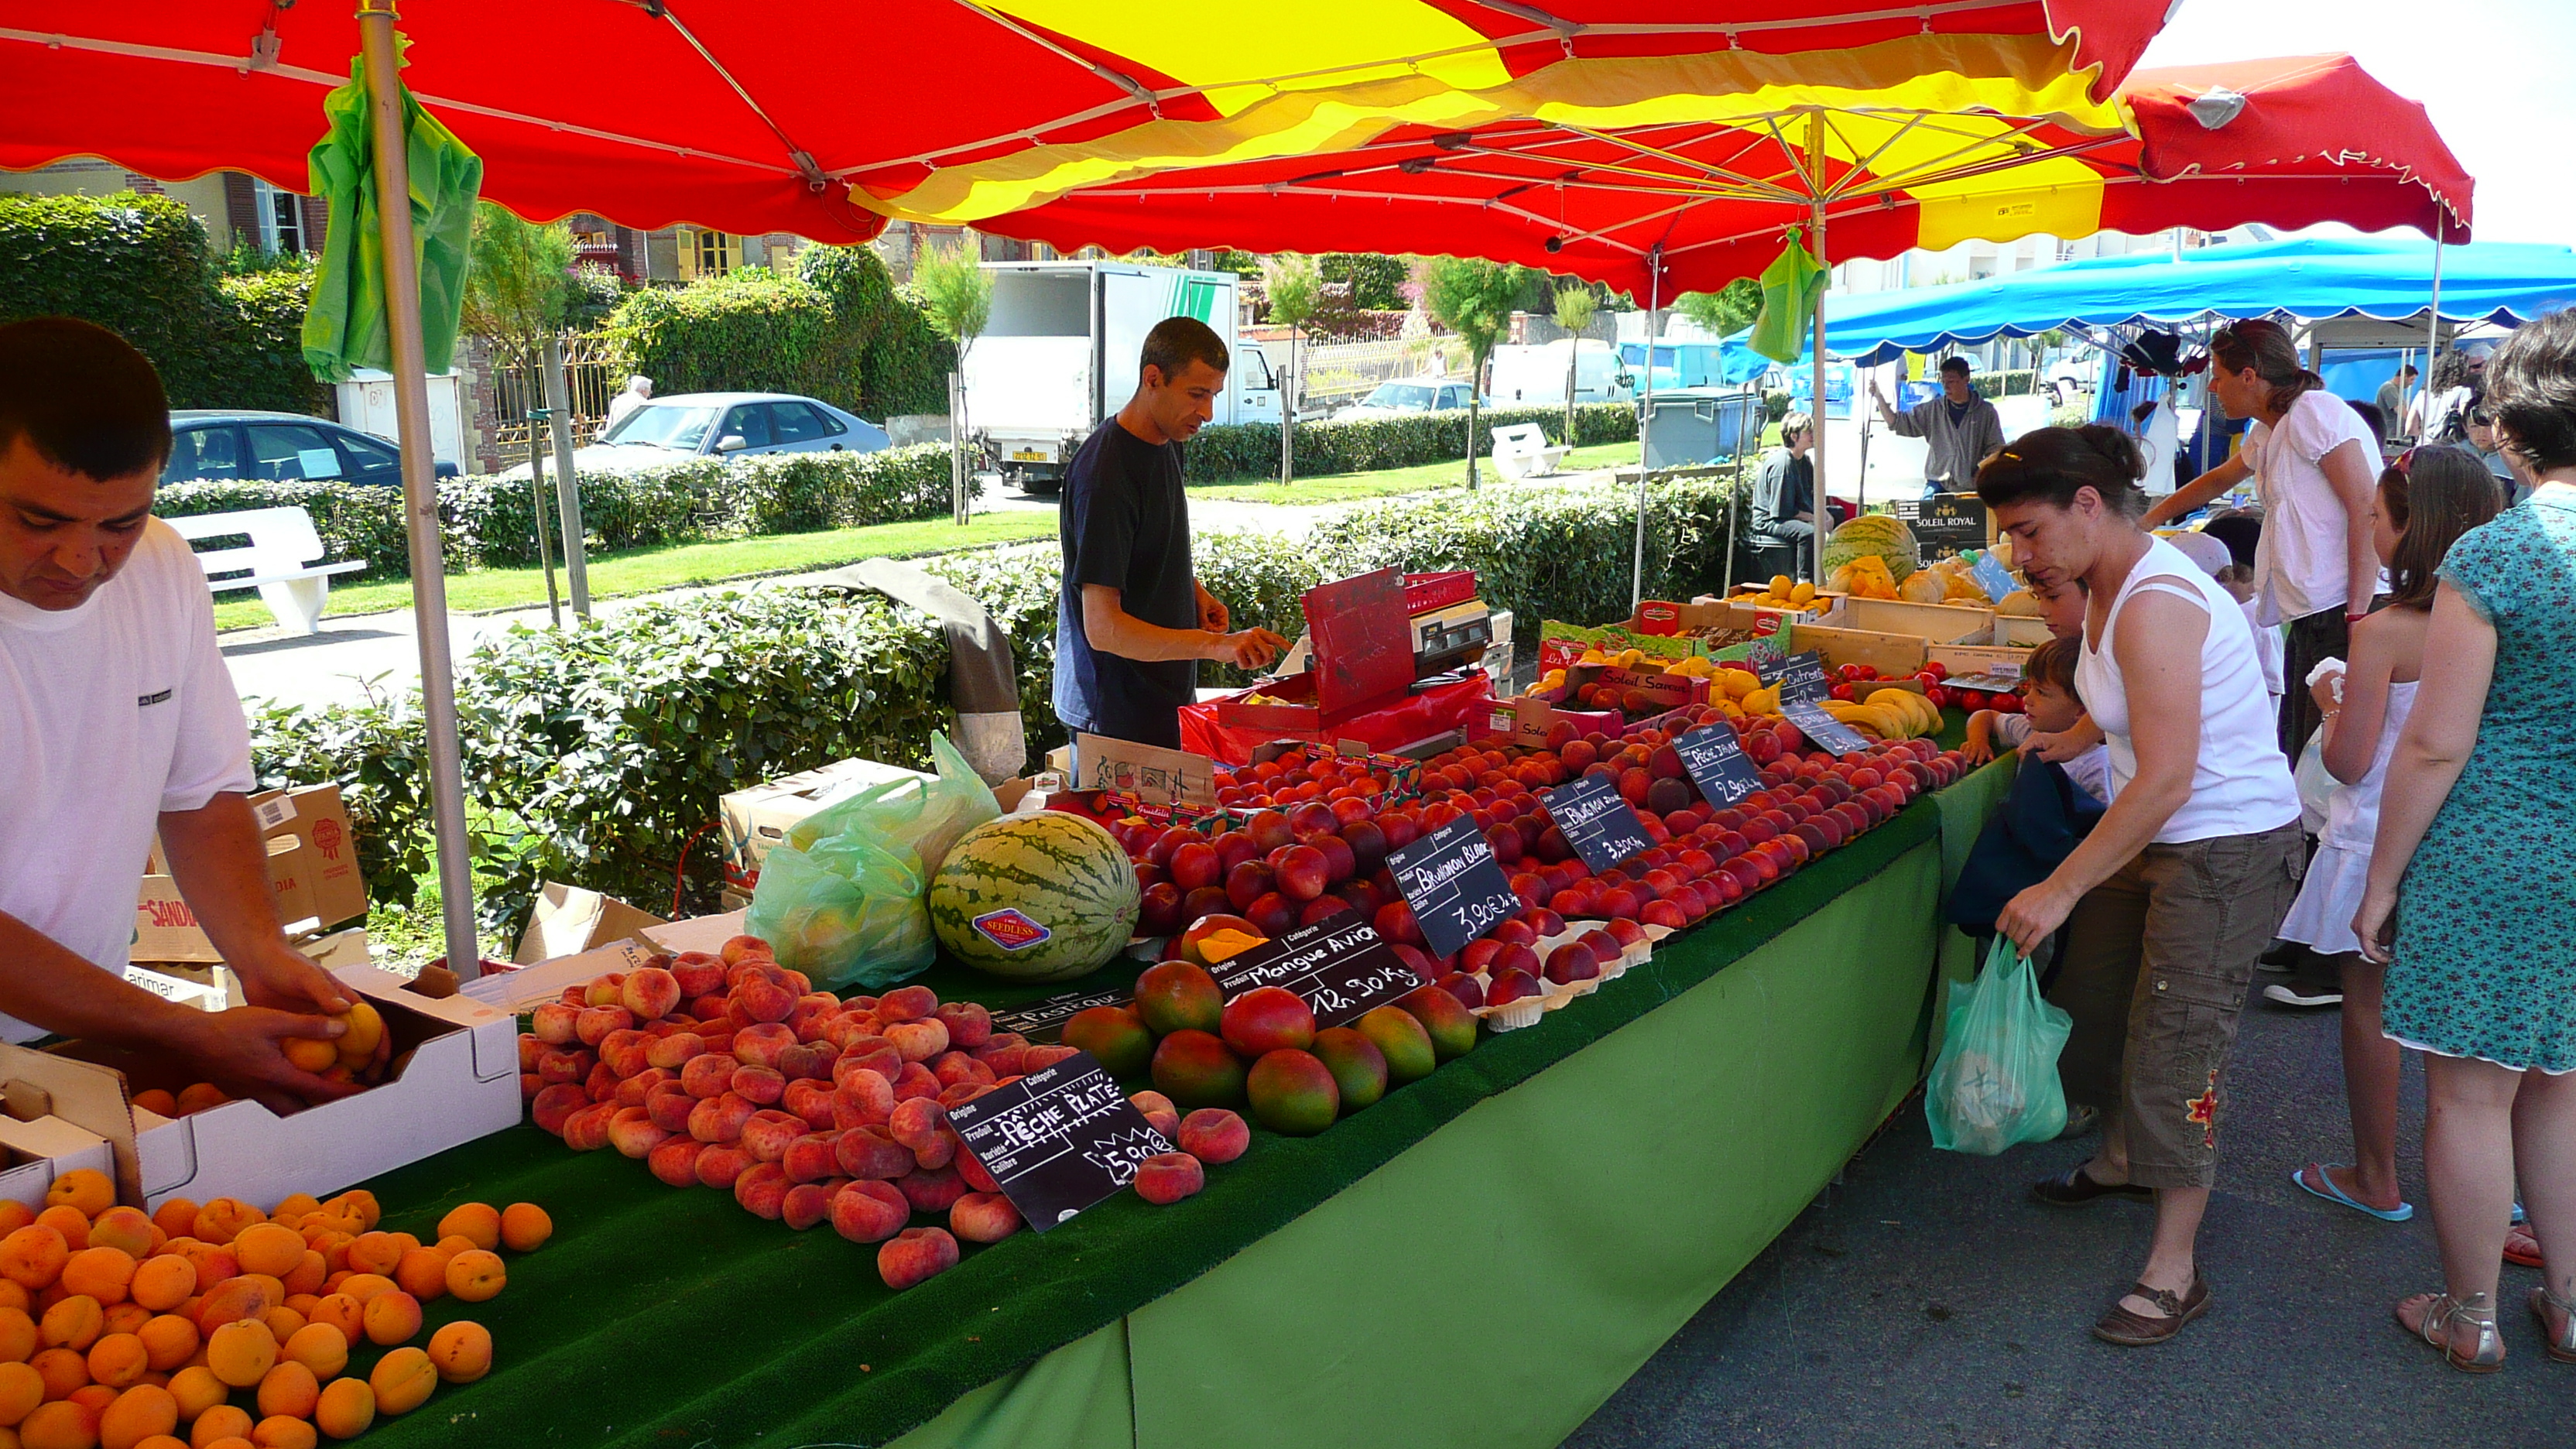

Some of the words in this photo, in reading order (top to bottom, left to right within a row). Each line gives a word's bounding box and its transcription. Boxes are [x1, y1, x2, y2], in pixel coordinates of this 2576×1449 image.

[1917, 518, 1946, 527] SOLEIL
[1947, 517, 1976, 526] ROYAL
[1604, 670, 1640, 687] Soleil
[987, 920, 1034, 936] SEEDLESS
[1211, 959, 1237, 975] Origine
[1286, 924, 1320, 943] Catégorie
[1222, 973, 1250, 990] Produit
[1249, 948, 1328, 987] Mangue
[949, 1103, 978, 1122] Origine
[1026, 1067, 1058, 1088] Catégorie
[965, 1125, 994, 1143] Produit
[1064, 1083, 1116, 1115] PLATE
[979, 1143, 1006, 1163] Variété
[990, 1156, 1018, 1175] Calibre
